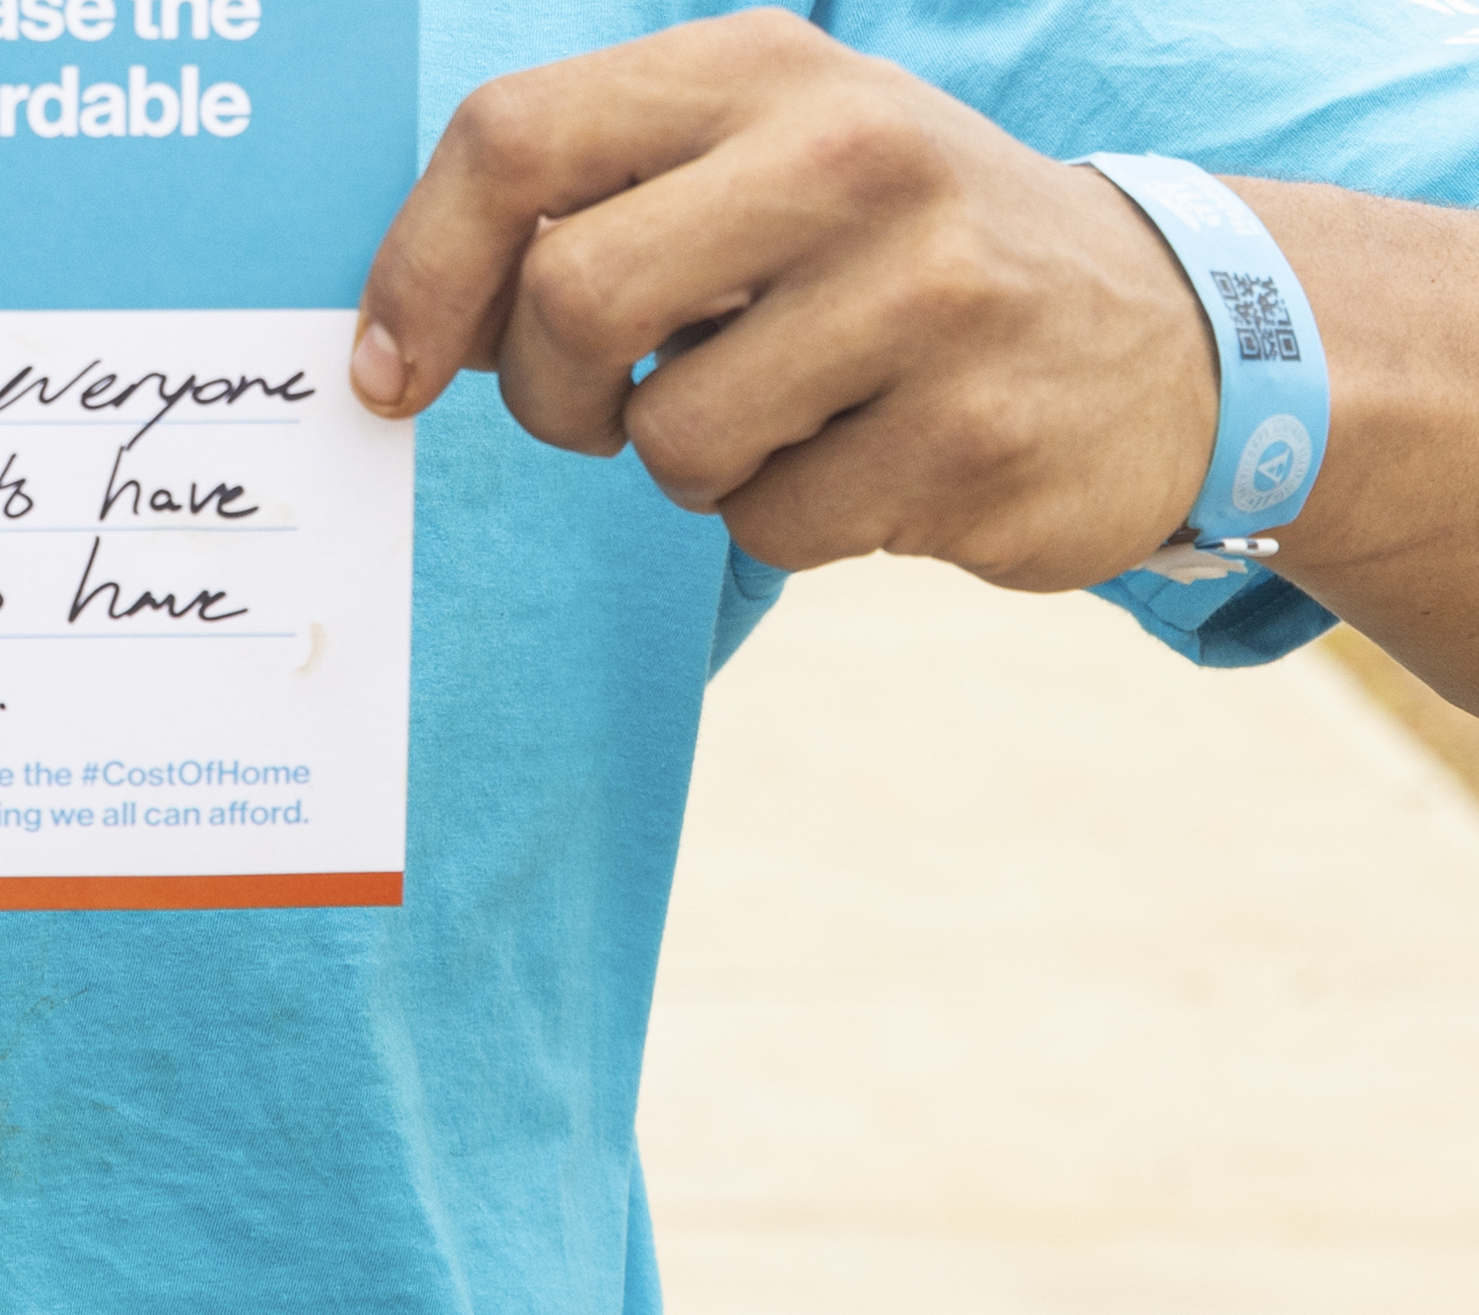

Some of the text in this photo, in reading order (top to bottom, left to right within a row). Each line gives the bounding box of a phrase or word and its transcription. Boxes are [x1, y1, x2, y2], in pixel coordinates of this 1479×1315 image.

[99, 446, 260, 522] have
[67, 536, 248, 623] have
[23, 761, 73, 787] the
[81, 759, 311, 787] #CostOfHome
[49, 807, 95, 827] we
[102, 801, 137, 827] all
[143, 806, 201, 827] can
[208, 799, 309, 826] afford.
